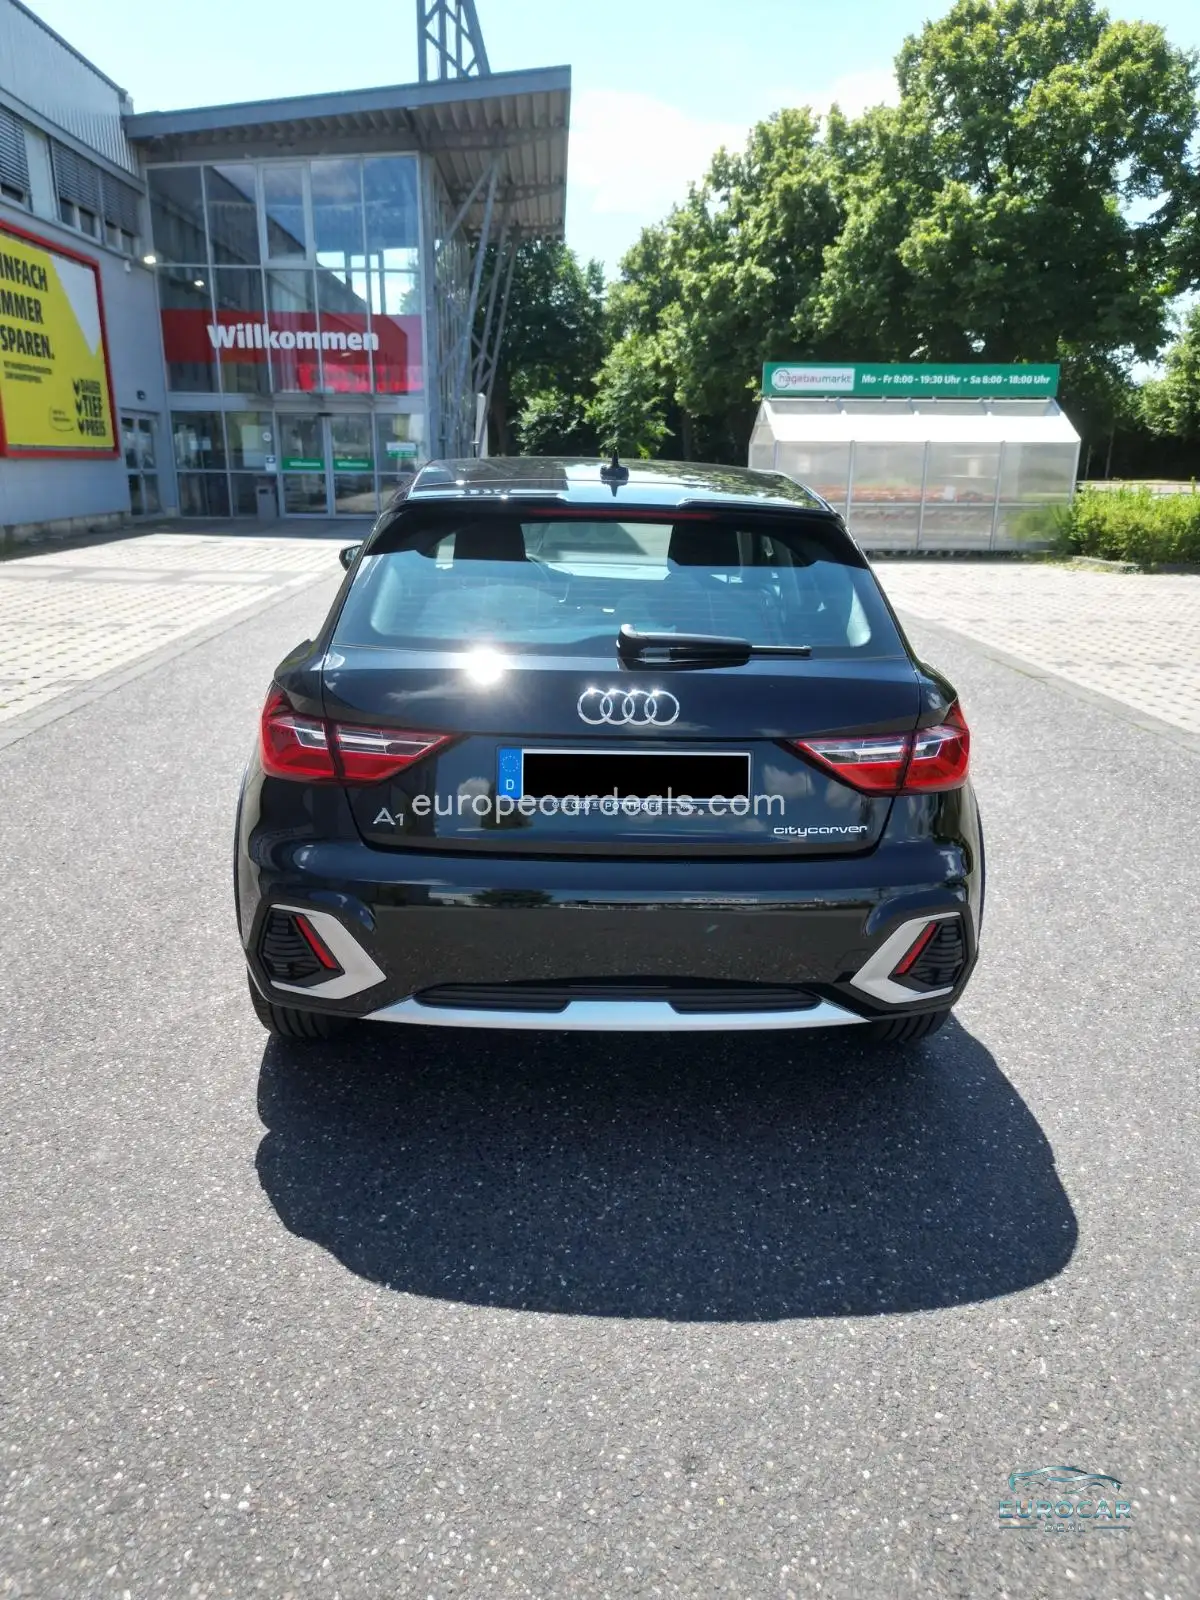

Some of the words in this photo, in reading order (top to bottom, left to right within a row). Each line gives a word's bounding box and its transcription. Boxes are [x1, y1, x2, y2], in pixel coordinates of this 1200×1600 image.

[0, 288, 44, 325] MMER
[0, 324, 55, 360] SPAREN.
[206, 323, 379, 351] Willkommen
[862, 374, 877, 383] Mo
[883, 374, 892, 383] Fr
[894, 374, 914, 383] 8:00
[921, 375, 942, 384] 19:30
[944, 375, 960, 384] Uhr
[970, 375, 981, 384] Sa
[982, 375, 1002, 384] 8:00
[1009, 375, 1032, 384] 18:00
[1034, 375, 1051, 384] Uhr
[505, 779, 515, 790] D
[372, 807, 404, 826] A1
[773, 824, 868, 837] citycarver
